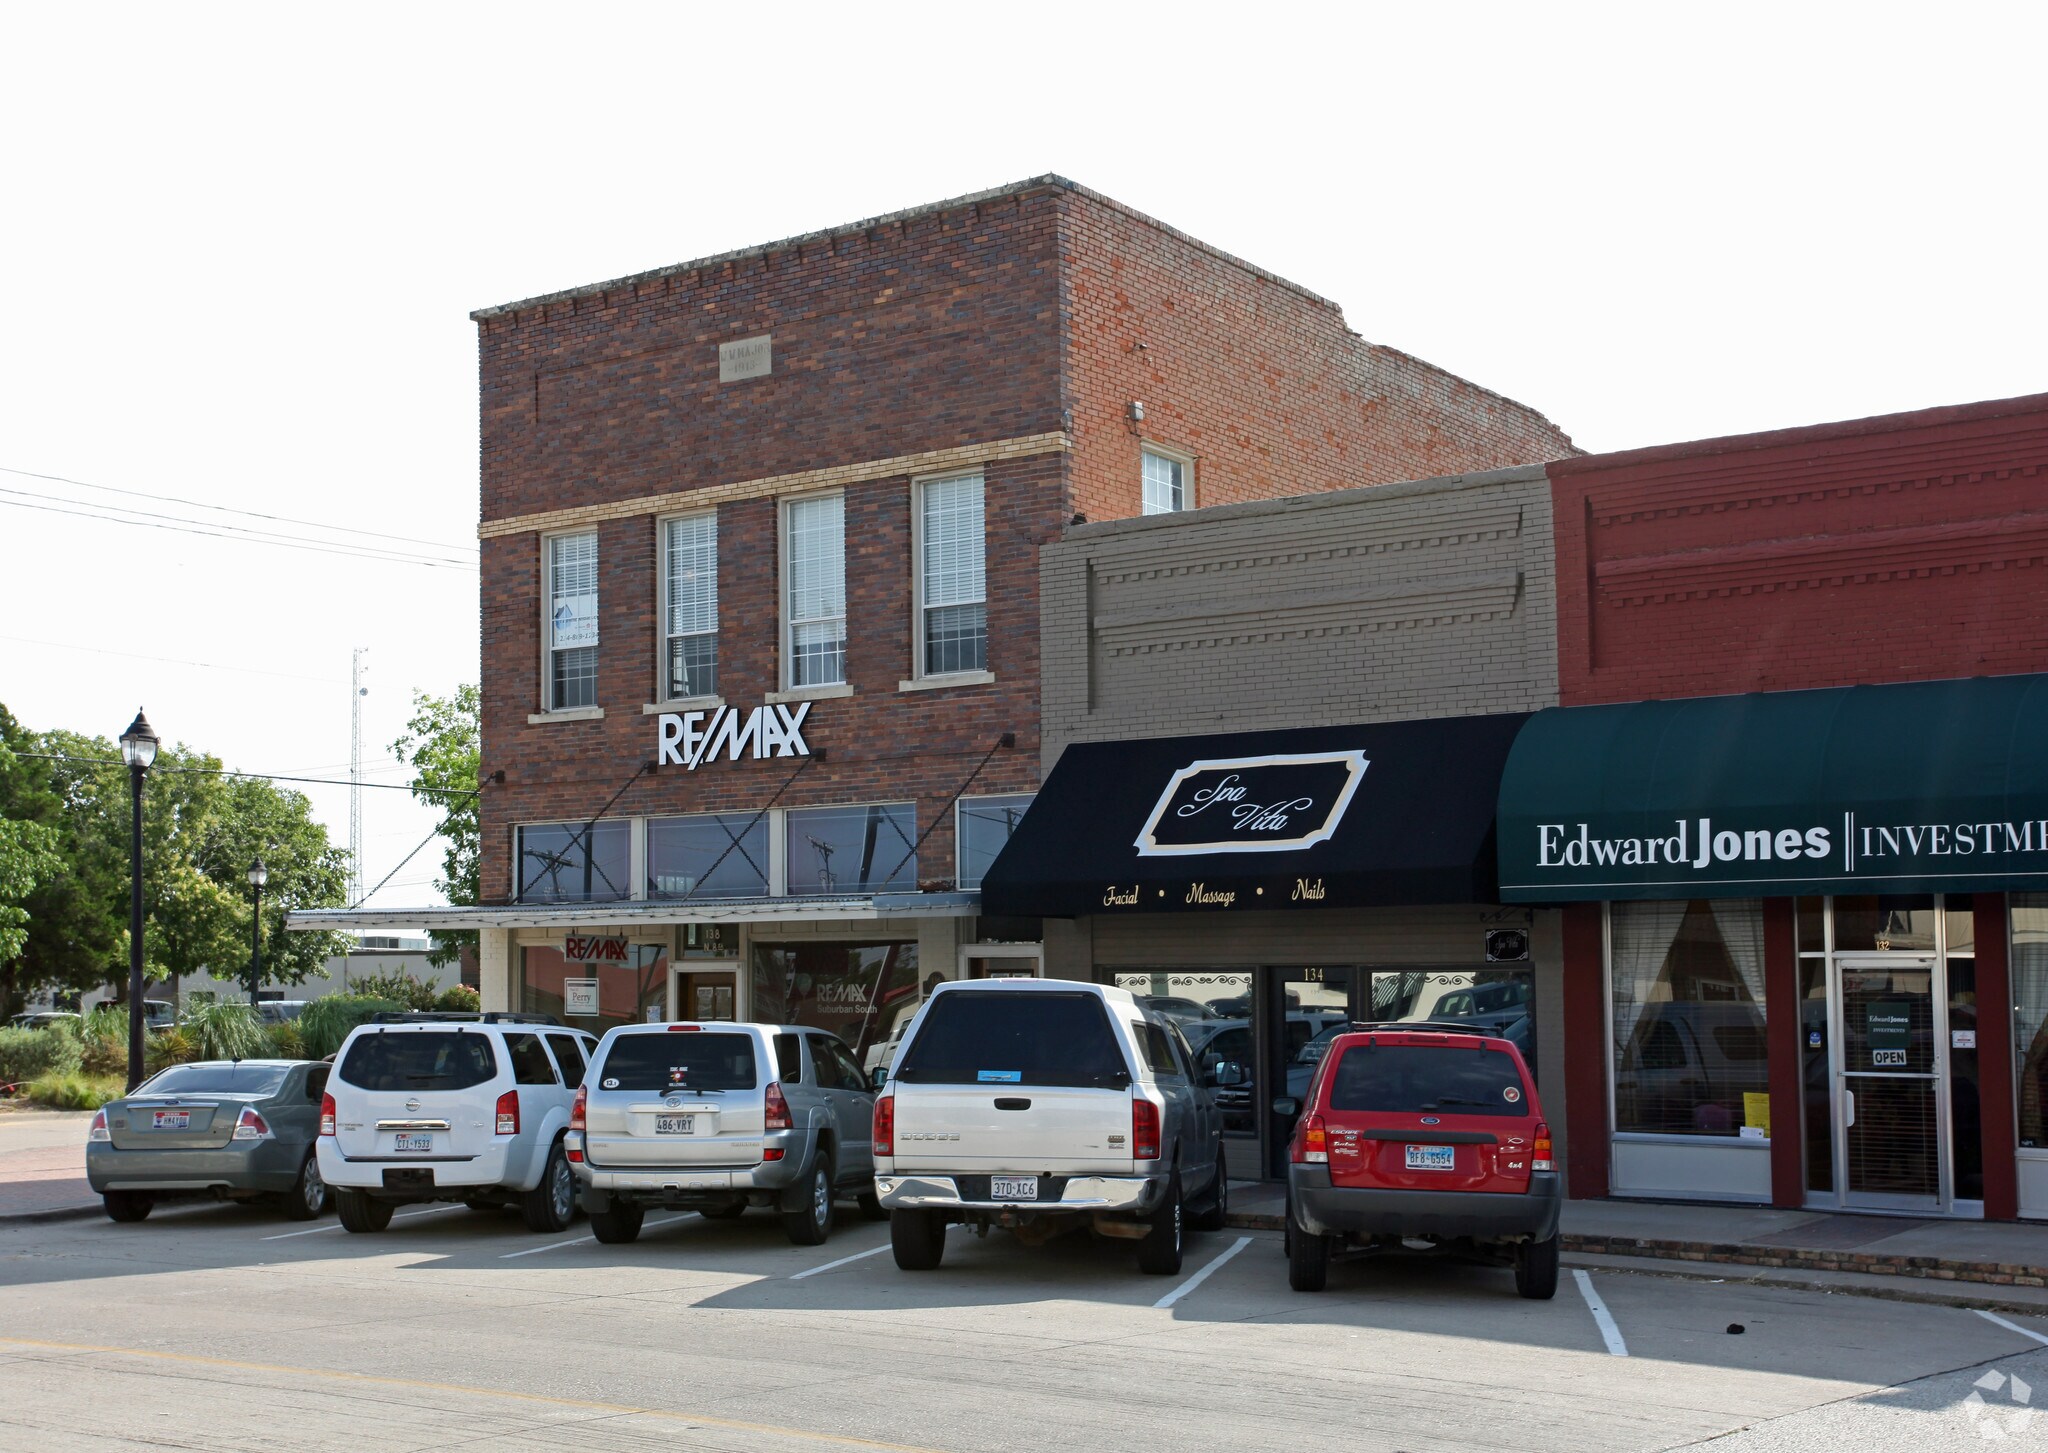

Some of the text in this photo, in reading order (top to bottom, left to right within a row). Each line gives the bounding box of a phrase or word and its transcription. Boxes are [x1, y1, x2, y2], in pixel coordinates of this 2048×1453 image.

[658, 702, 811, 771] RE/MAX
[1177, 774, 1247, 817] Spa
[1232, 797, 1313, 831] Vita
[1103, 878, 1325, 907] Facial Massage Nails
[705, 928, 720, 939] 138
[565, 936, 628, 961] RE/MAX
[1876, 940, 1890, 951] 132
[1304, 967, 1324, 981] 134
[573, 992, 591, 1004] Perry
[817, 1004, 878, 1014] Suburban South
[1875, 1051, 1905, 1064] OPEN
